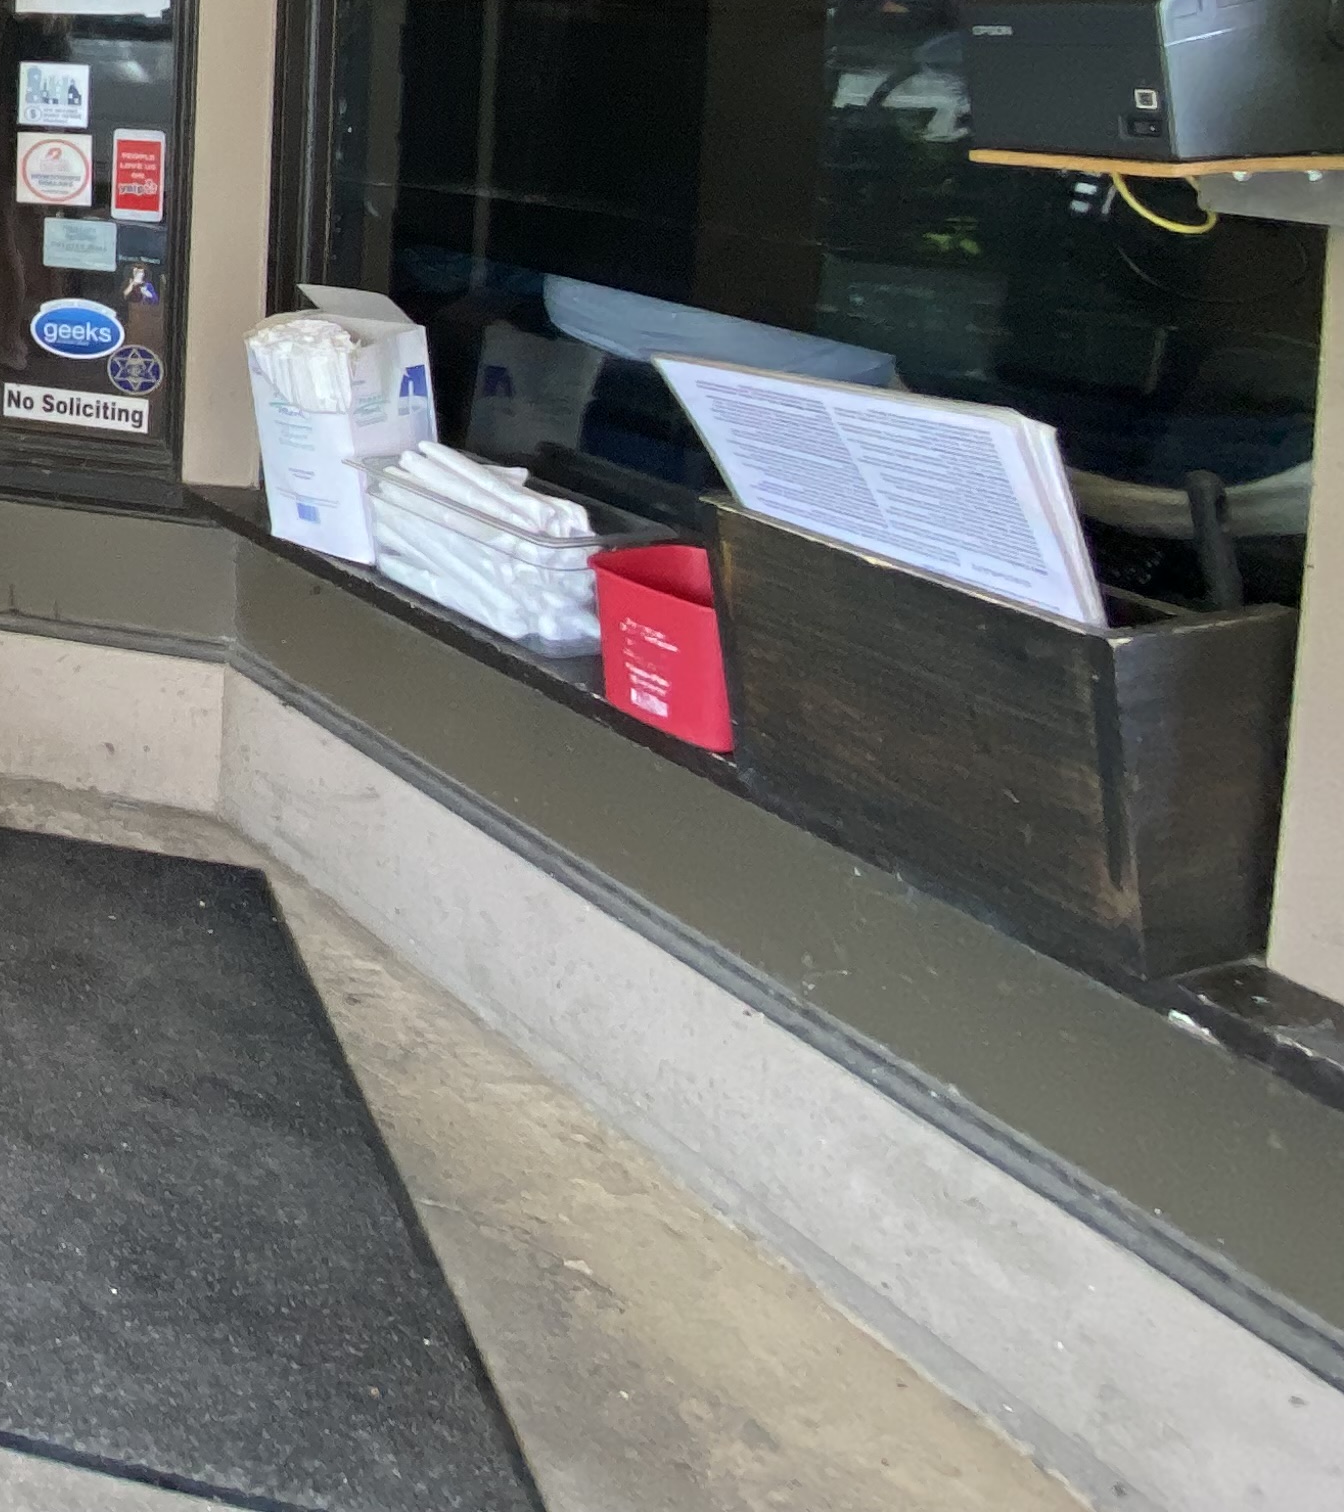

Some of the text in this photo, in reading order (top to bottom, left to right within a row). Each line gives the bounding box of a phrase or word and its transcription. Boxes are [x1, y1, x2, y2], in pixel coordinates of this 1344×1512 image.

[43, 321, 112, 343] geeks
[6, 389, 144, 429] No Soliciting
